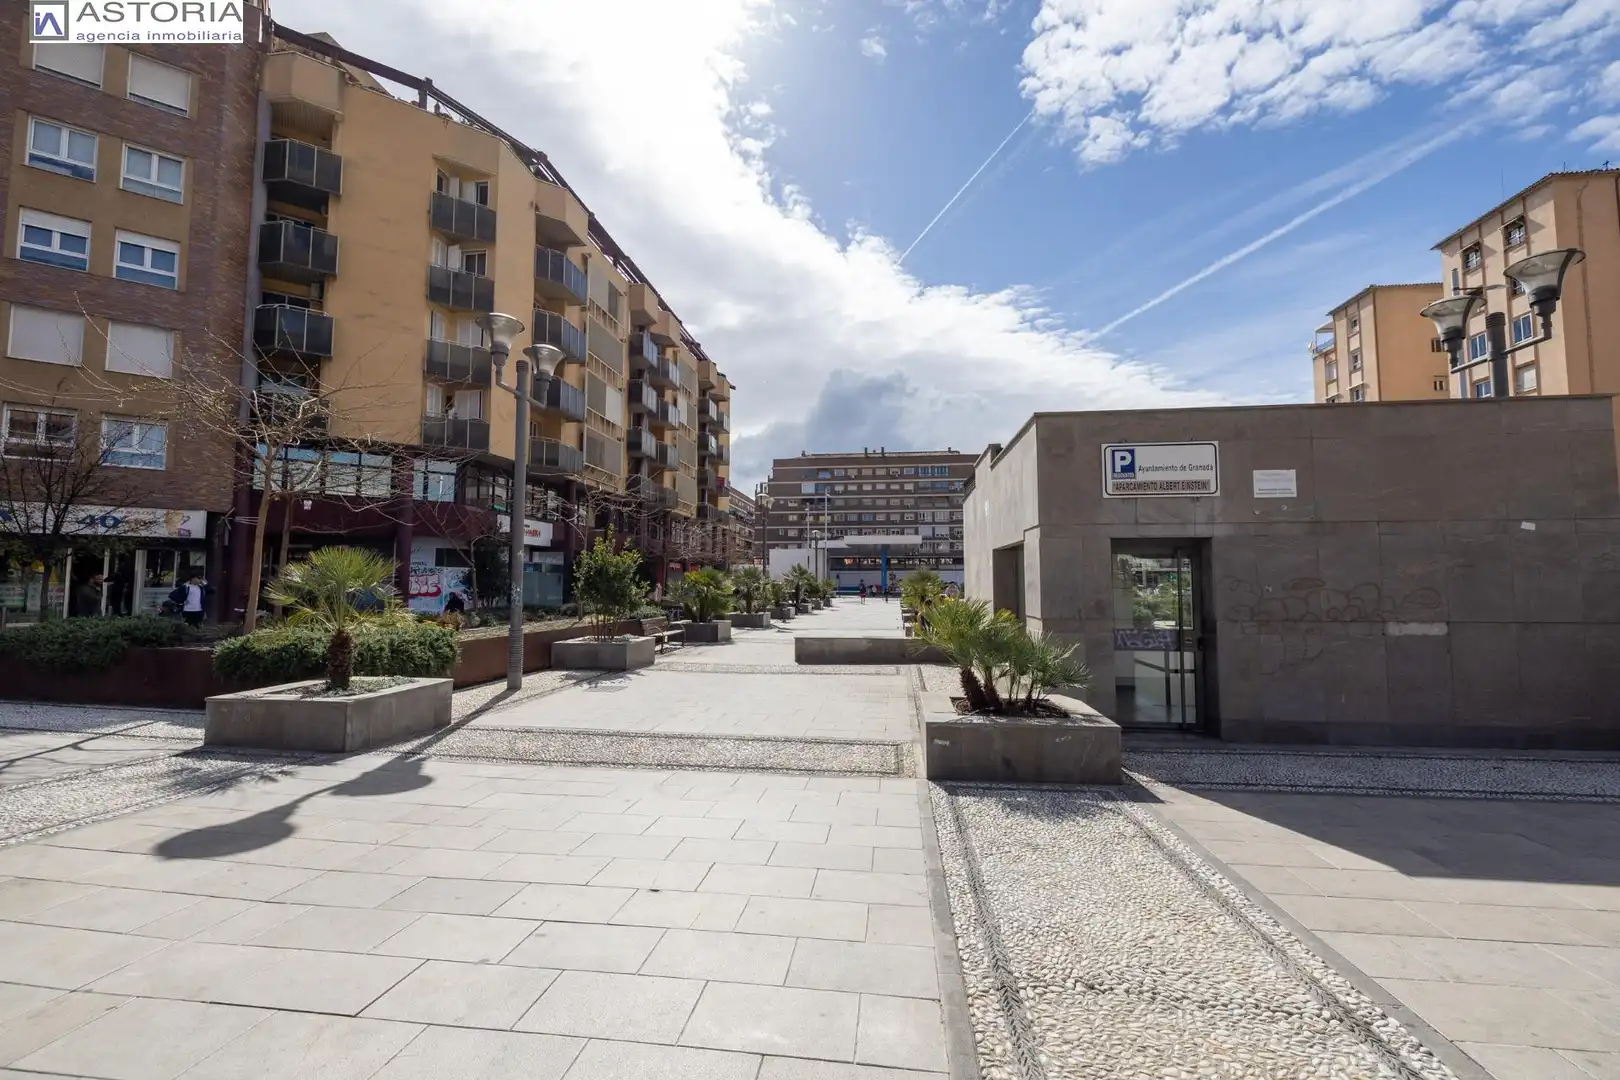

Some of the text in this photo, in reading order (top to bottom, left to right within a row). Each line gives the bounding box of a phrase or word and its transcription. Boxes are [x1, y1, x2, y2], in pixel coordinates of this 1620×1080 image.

[1114, 451, 1132, 473] P
[1138, 463, 1214, 473] Ayuntamiento de Granada
[1159, 480, 1181, 491] ALBERT
